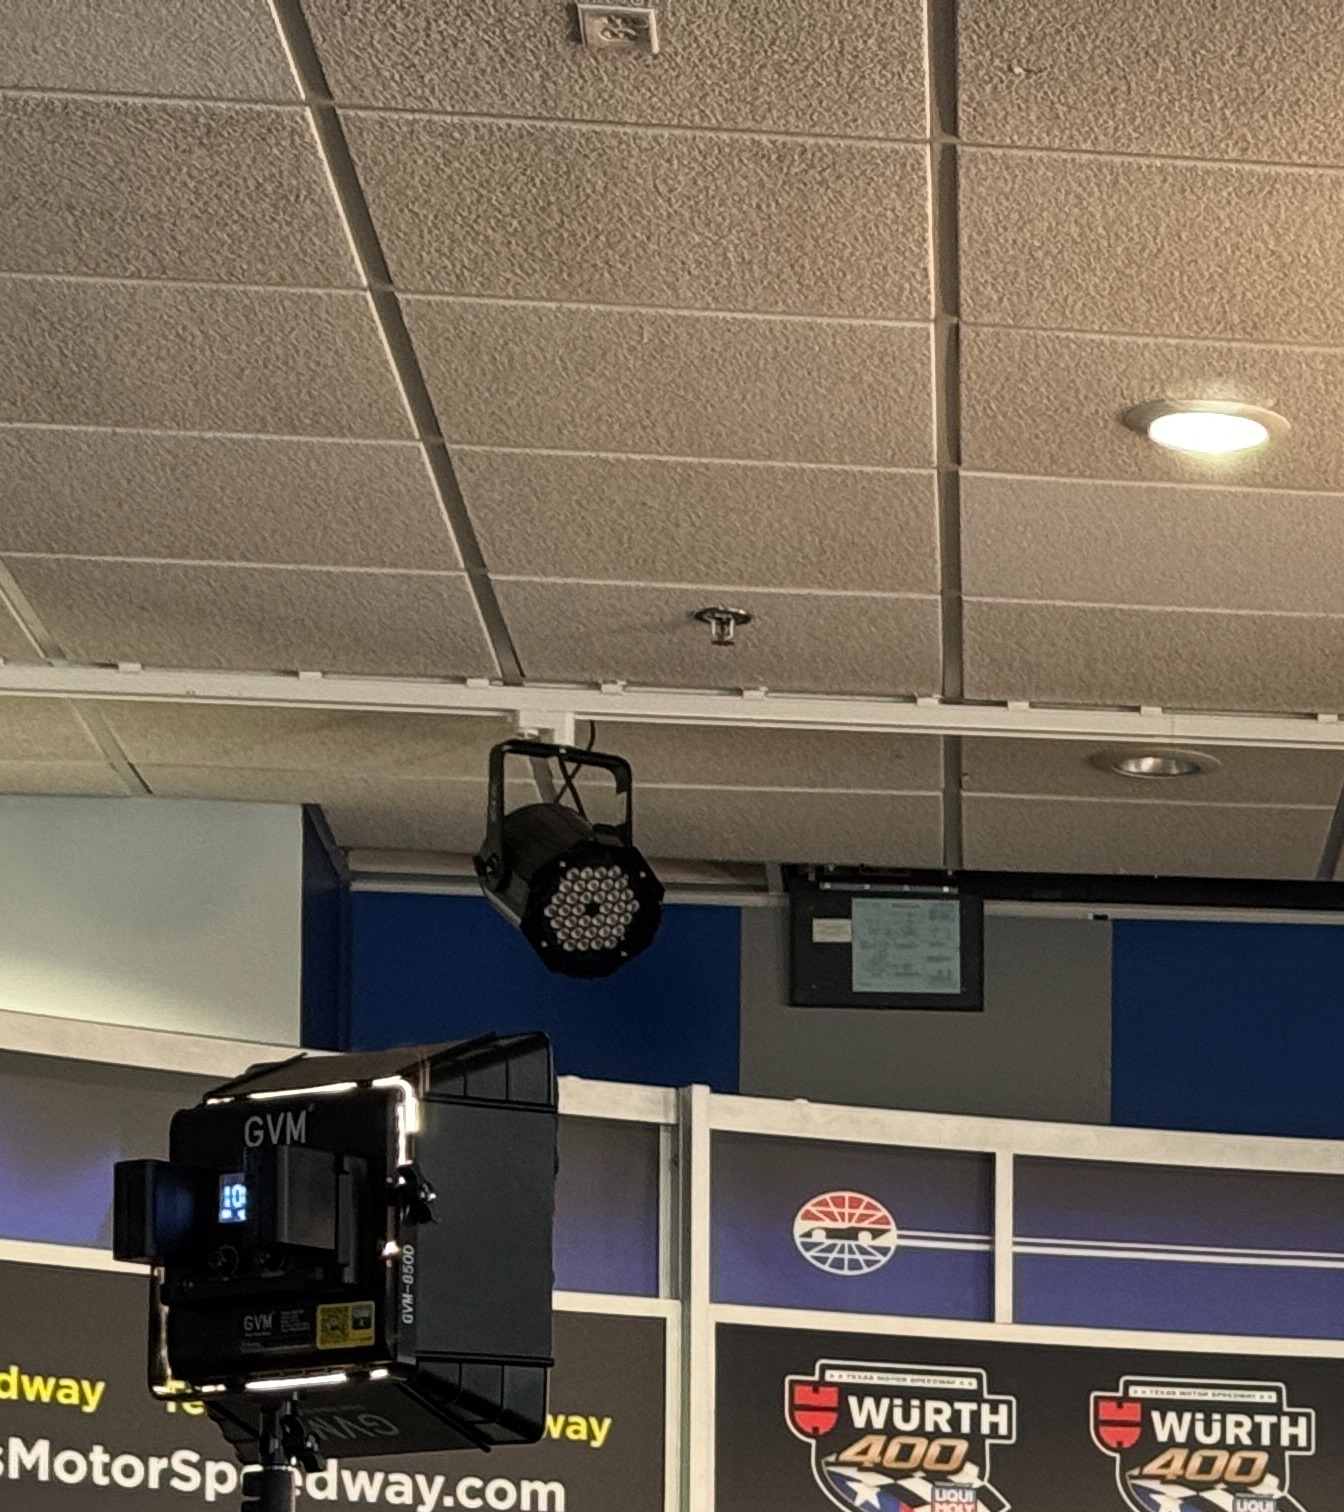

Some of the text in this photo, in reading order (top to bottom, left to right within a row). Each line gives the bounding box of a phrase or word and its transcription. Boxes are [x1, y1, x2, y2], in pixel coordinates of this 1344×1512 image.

[244, 1109, 307, 1147] GVM
[243, 1313, 273, 1332] GVM
[848, 1395, 1008, 1435] WÜRTH
[1150, 1409, 1307, 1447] WÜRTH
[838, 1434, 969, 1471] 400
[1141, 1447, 1269, 1483] 400
[935, 1488, 974, 1504] LIQUI
[1236, 1499, 1274, 1512] LIQUI
